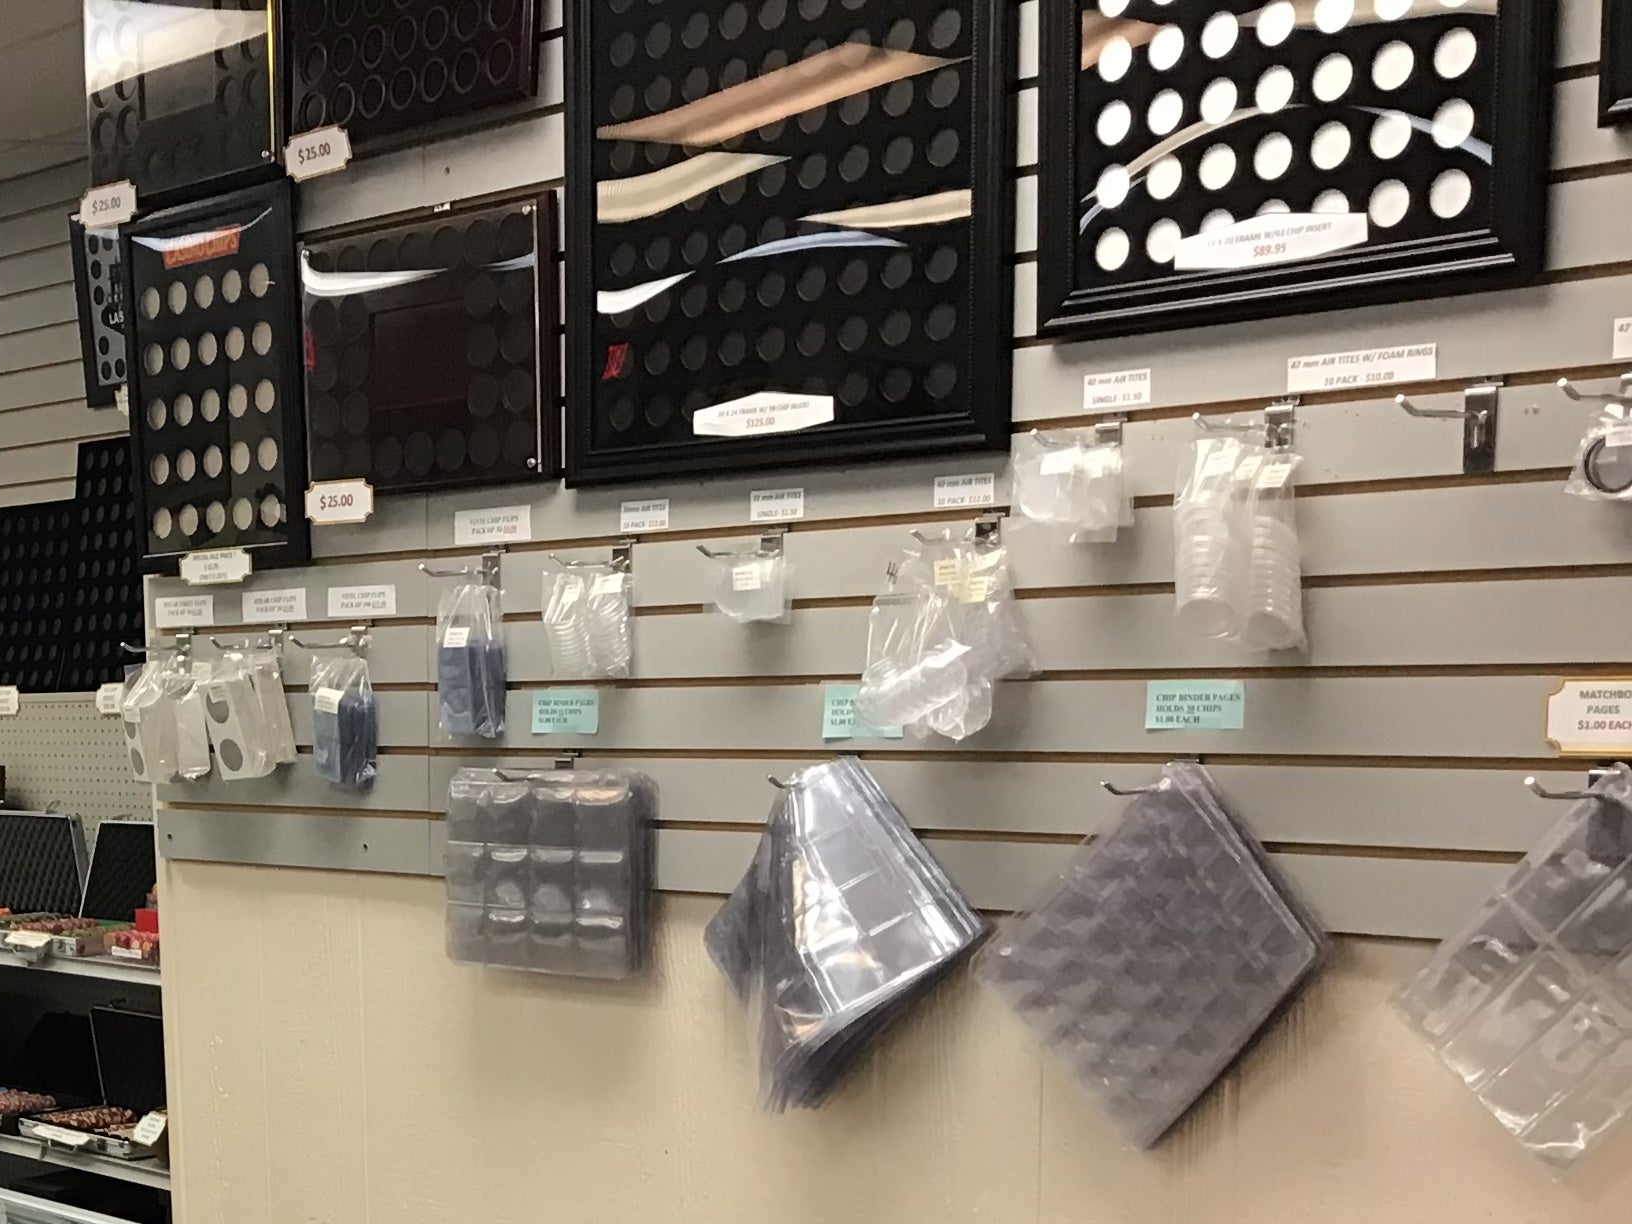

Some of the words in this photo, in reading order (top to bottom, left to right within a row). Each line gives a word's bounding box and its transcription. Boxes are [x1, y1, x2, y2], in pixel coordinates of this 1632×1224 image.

[1235, 232, 1262, 244] FRAME
[1306, 222, 1332, 233] INSERT
[1253, 243, 1287, 257] $89.95
[1321, 358, 1336, 366] AIR
[1338, 355, 1360, 365] TITES
[1377, 349, 1405, 361] FOAM
[1406, 347, 1434, 358] RINGS
[1335, 375, 1359, 385] PACK
[1196, 704, 1222, 712] CHIPS
[1587, 704, 1620, 714] PAGES
[1578, 720, 1606, 730] $1.00
